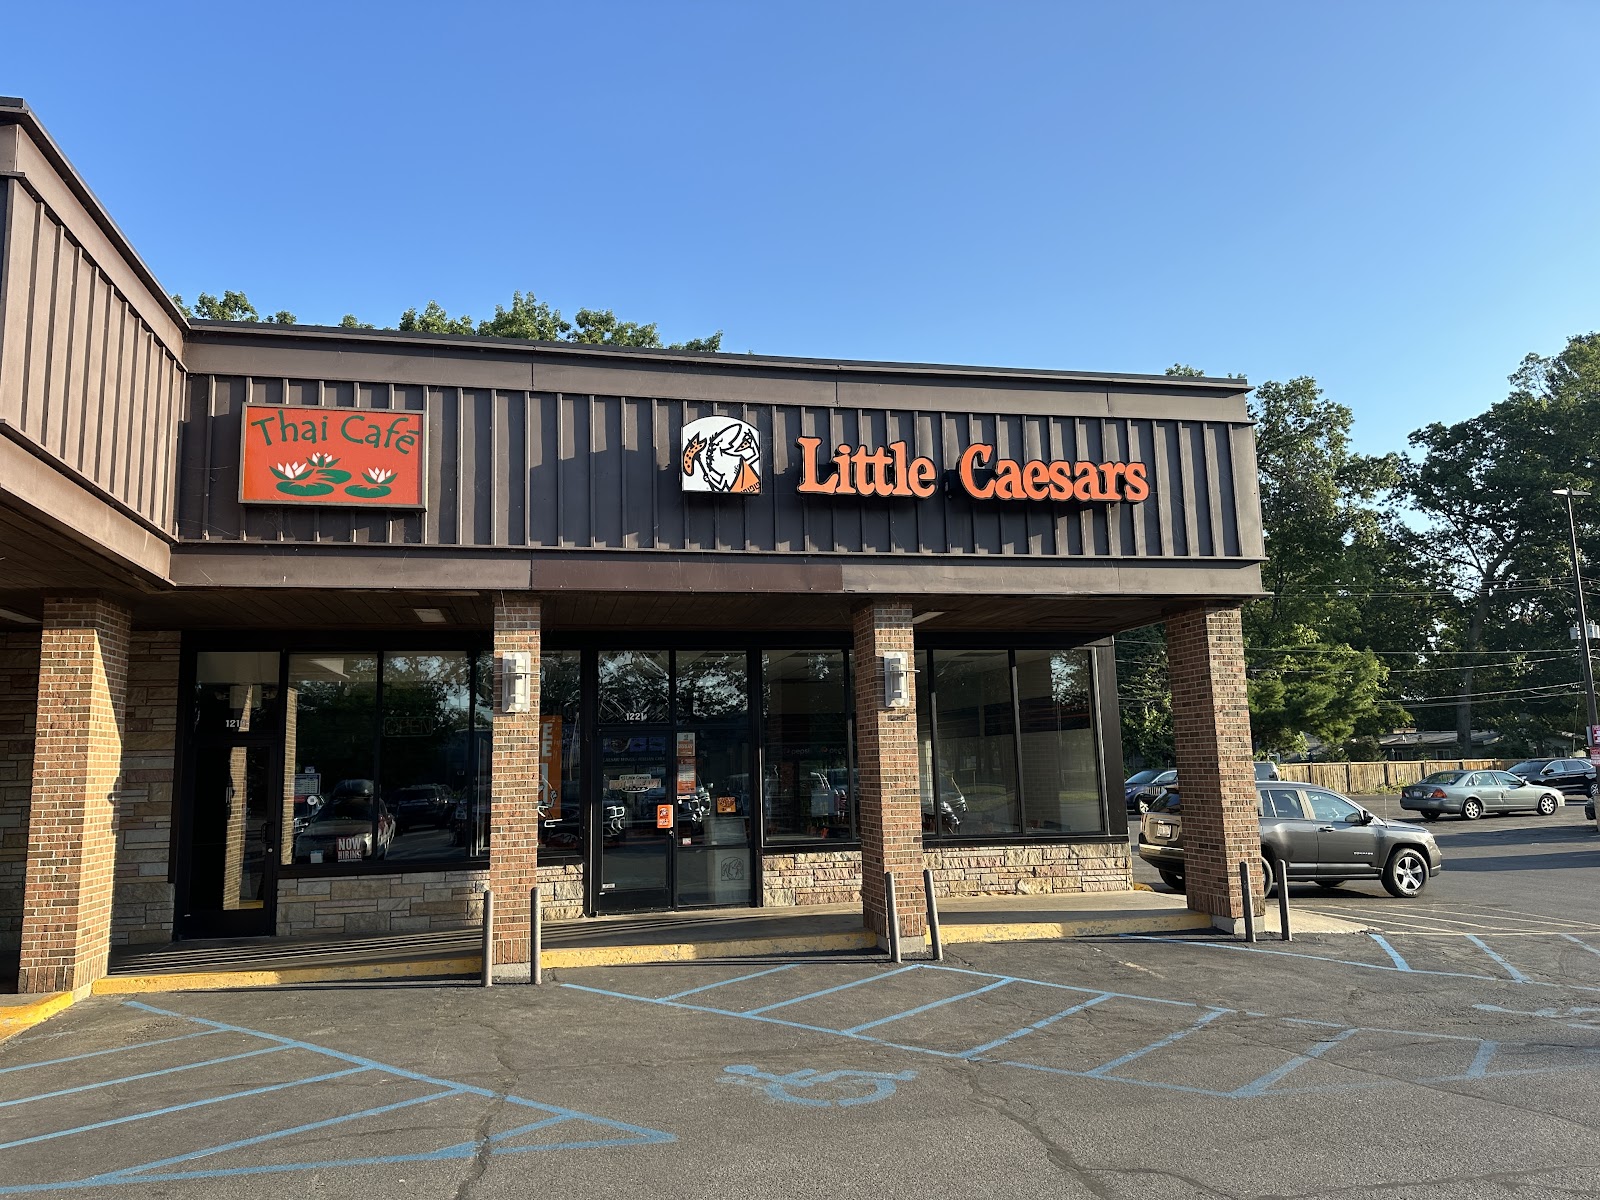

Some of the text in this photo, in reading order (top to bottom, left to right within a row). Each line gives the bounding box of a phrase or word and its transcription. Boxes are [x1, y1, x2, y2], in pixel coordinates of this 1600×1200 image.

[251, 409, 420, 455] Thai Café
[797, 437, 1150, 501] Little Caesars
[337, 850, 362, 860] HIRING
[338, 837, 361, 850] NOW
